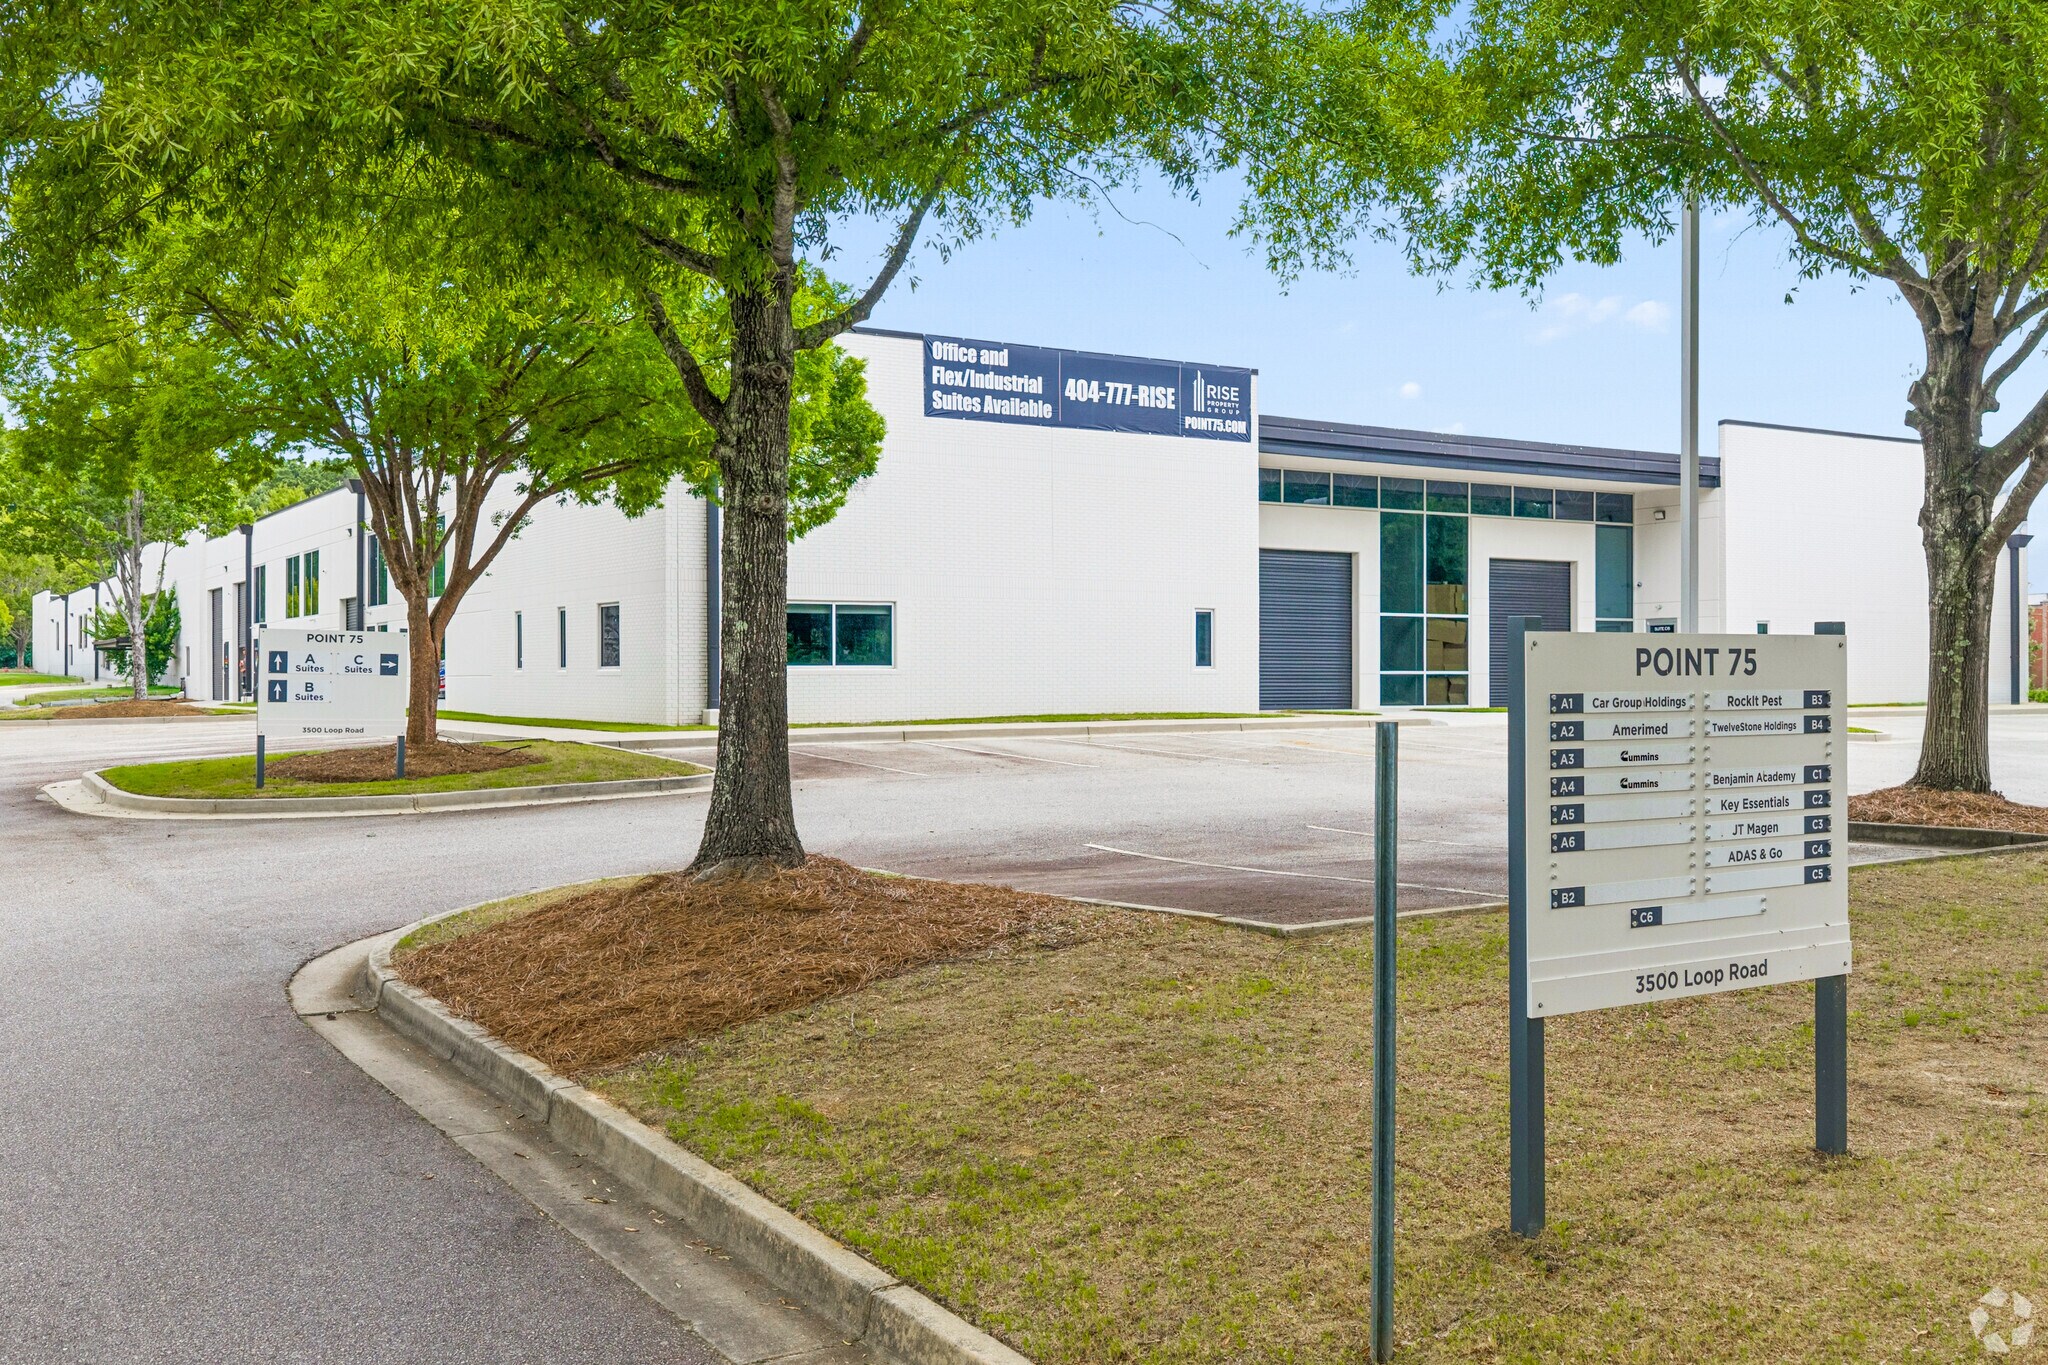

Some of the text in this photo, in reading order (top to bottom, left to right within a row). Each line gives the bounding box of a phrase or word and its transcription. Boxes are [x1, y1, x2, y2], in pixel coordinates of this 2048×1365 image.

[932, 340, 1008, 367] Office and
[932, 366, 1042, 394] Flex/Industrial
[1065, 378, 1175, 410] 404-777-RISE
[1207, 385, 1239, 401] RISE
[932, 390, 1052, 418] Suites Available
[1207, 400, 1239, 408] PROPERTY
[1207, 407, 1240, 415] GROUP
[1185, 416, 1247, 434] POINT75.COM
[307, 633, 363, 644] POINT 75
[305, 654, 315, 664] A
[354, 655, 363, 665] C
[1636, 647, 1757, 676] POINT 75
[295, 664, 324, 672] Suites
[344, 665, 372, 673] Suites
[305, 682, 314, 692] B
[295, 693, 324, 701] Suites
[1560, 695, 1686, 711] A1 Car Group Holdings
[1761, 695, 1782, 706] Pest
[1811, 695, 1823, 705] B3
[1560, 723, 1668, 738] A2 Amerimed
[1712, 720, 1823, 732] TwelveStone Holdings B4
[1560, 750, 1659, 765] A3 Cummins
[1713, 770, 1822, 786] Benjamin Academy C1
[1560, 778, 1659, 793] A4 Cummins
[1721, 795, 1823, 812] Key Essentials C2
[1560, 809, 1575, 821] A5
[1732, 819, 1824, 837] JT Magen C3
[1560, 836, 1575, 849] A6
[1728, 844, 1824, 863] ADAS & Go C4
[1812, 869, 1824, 880] C5
[1562, 893, 1575, 904] B2
[1640, 912, 1653, 923] C6
[1636, 958, 1768, 994] 3500 Loop Road
